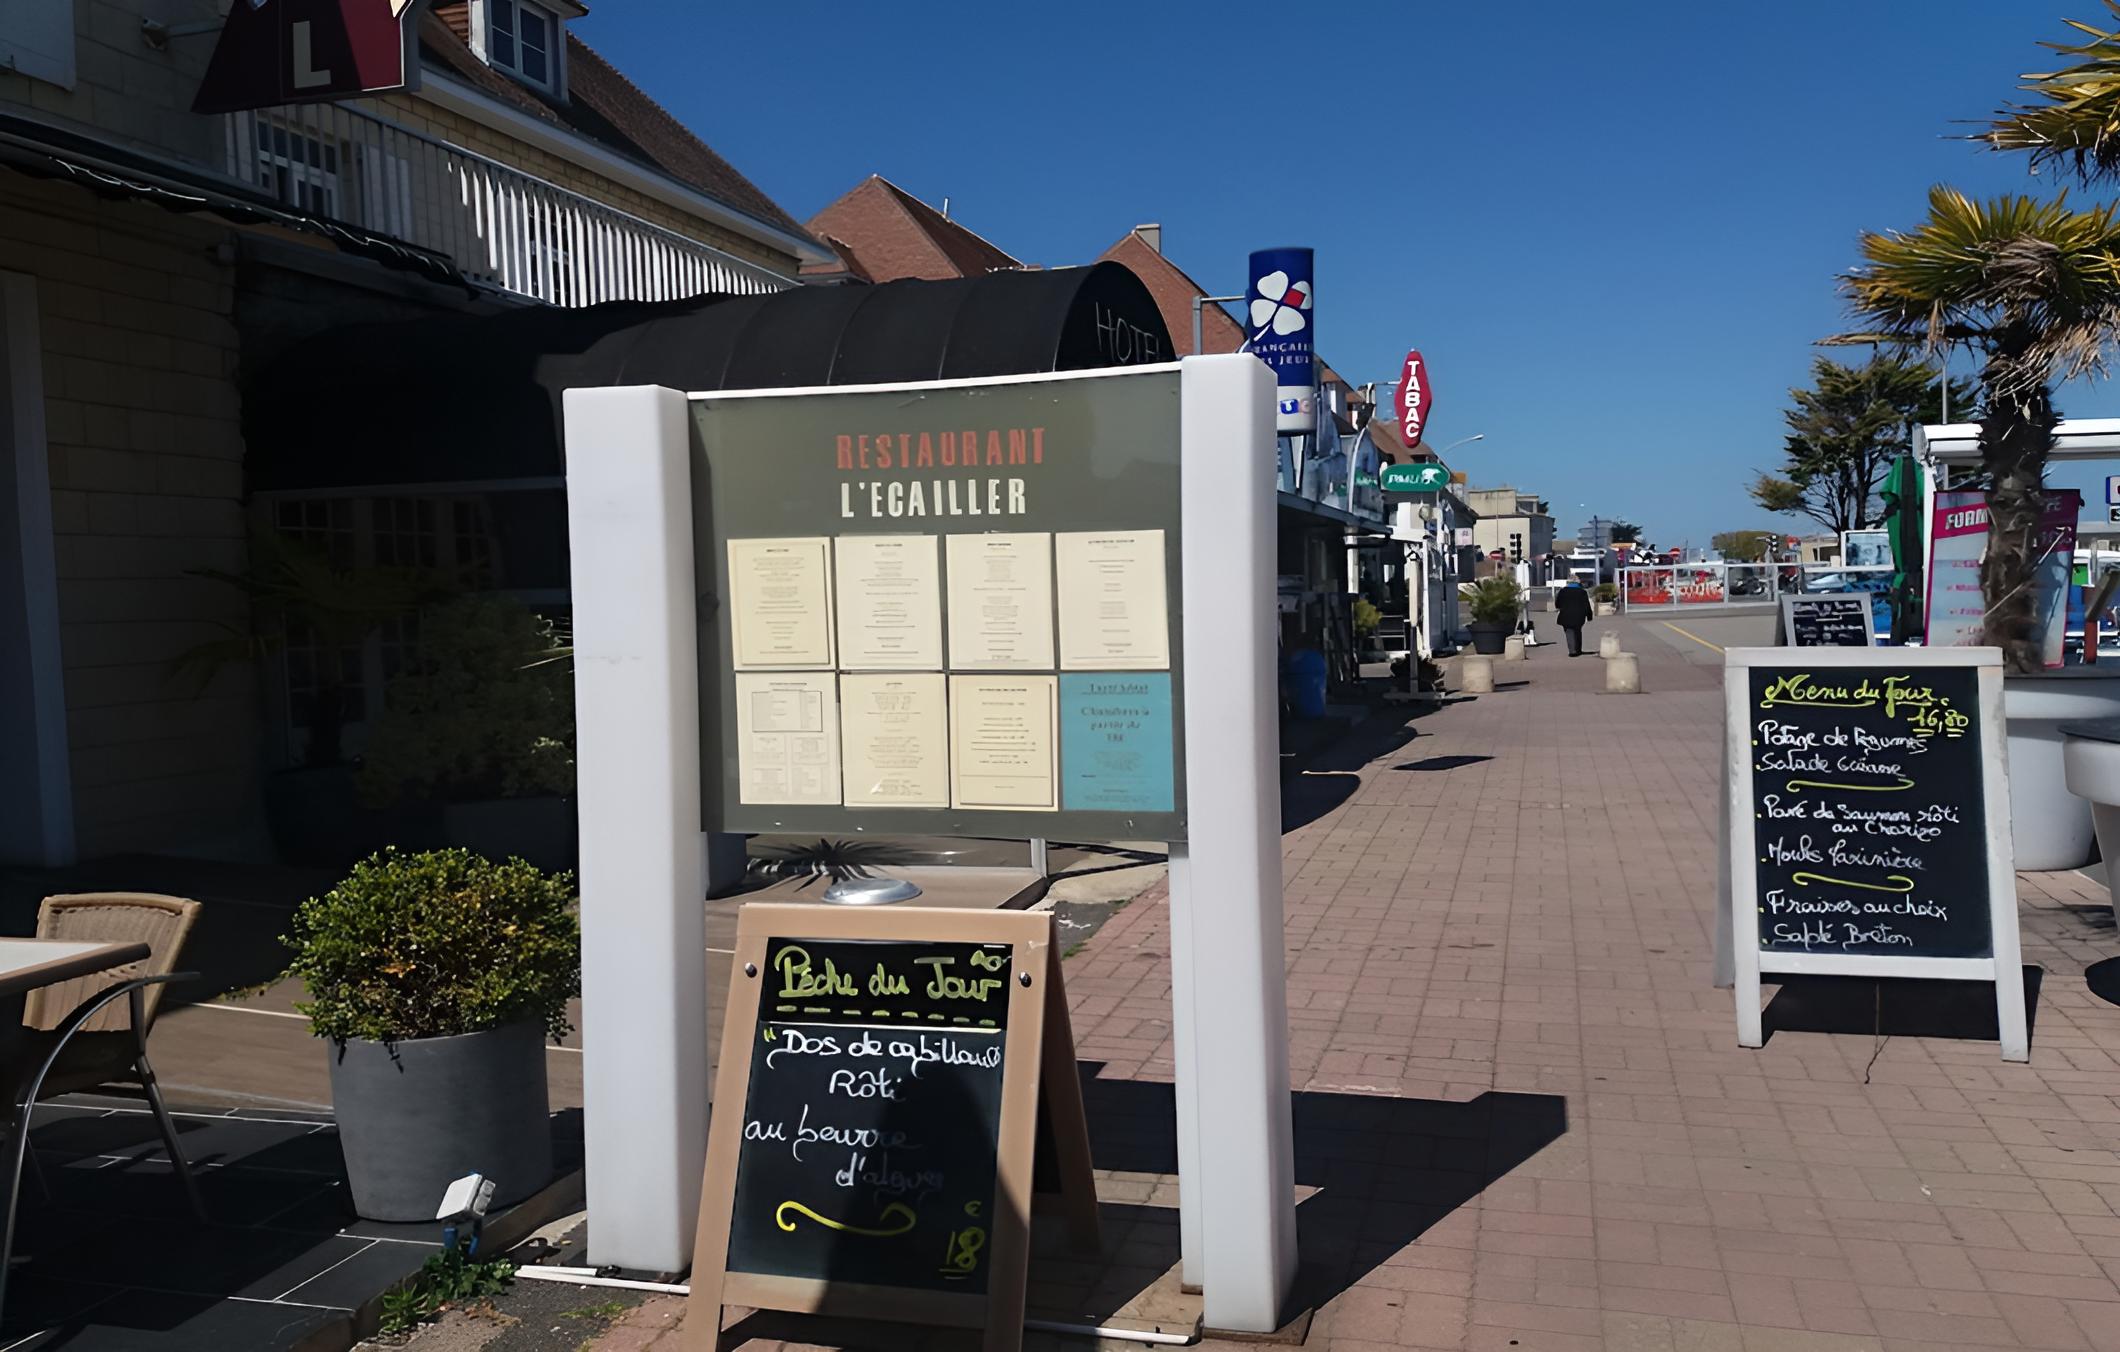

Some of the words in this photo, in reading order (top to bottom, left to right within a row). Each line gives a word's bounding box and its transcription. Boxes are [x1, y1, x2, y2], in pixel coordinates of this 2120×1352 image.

[292, 20, 331, 89] L
[1405, 360, 1421, 438] TABAC
[836, 427, 1046, 470] RESTAURANT
[840, 478, 1027, 518] L'ECAILLER
[1945, 508, 1989, 530] FORM
[1765, 674, 1849, 701] Menu
[1853, 679, 1880, 700] du
[1883, 675, 1937, 719] Jour
[1758, 720, 1820, 752] Potage
[1823, 727, 1848, 746] de
[1760, 750, 1832, 773] Salade
[1813, 801, 1836, 820] de
[1832, 823, 1857, 833] au
[1766, 889, 1860, 915] Fraises
[1863, 902, 1889, 914] au
[1892, 893, 1947, 921] choix
[1842, 922, 1913, 950] Breton
[868, 962, 910, 996] du
[913, 957, 1002, 1002] Jour
[848, 1031, 883, 1057] de
[828, 1067, 906, 1100] Rôti
[744, 1119, 787, 1141] au
[792, 1103, 923, 1162] beurre
[945, 1226, 986, 1270] 18
